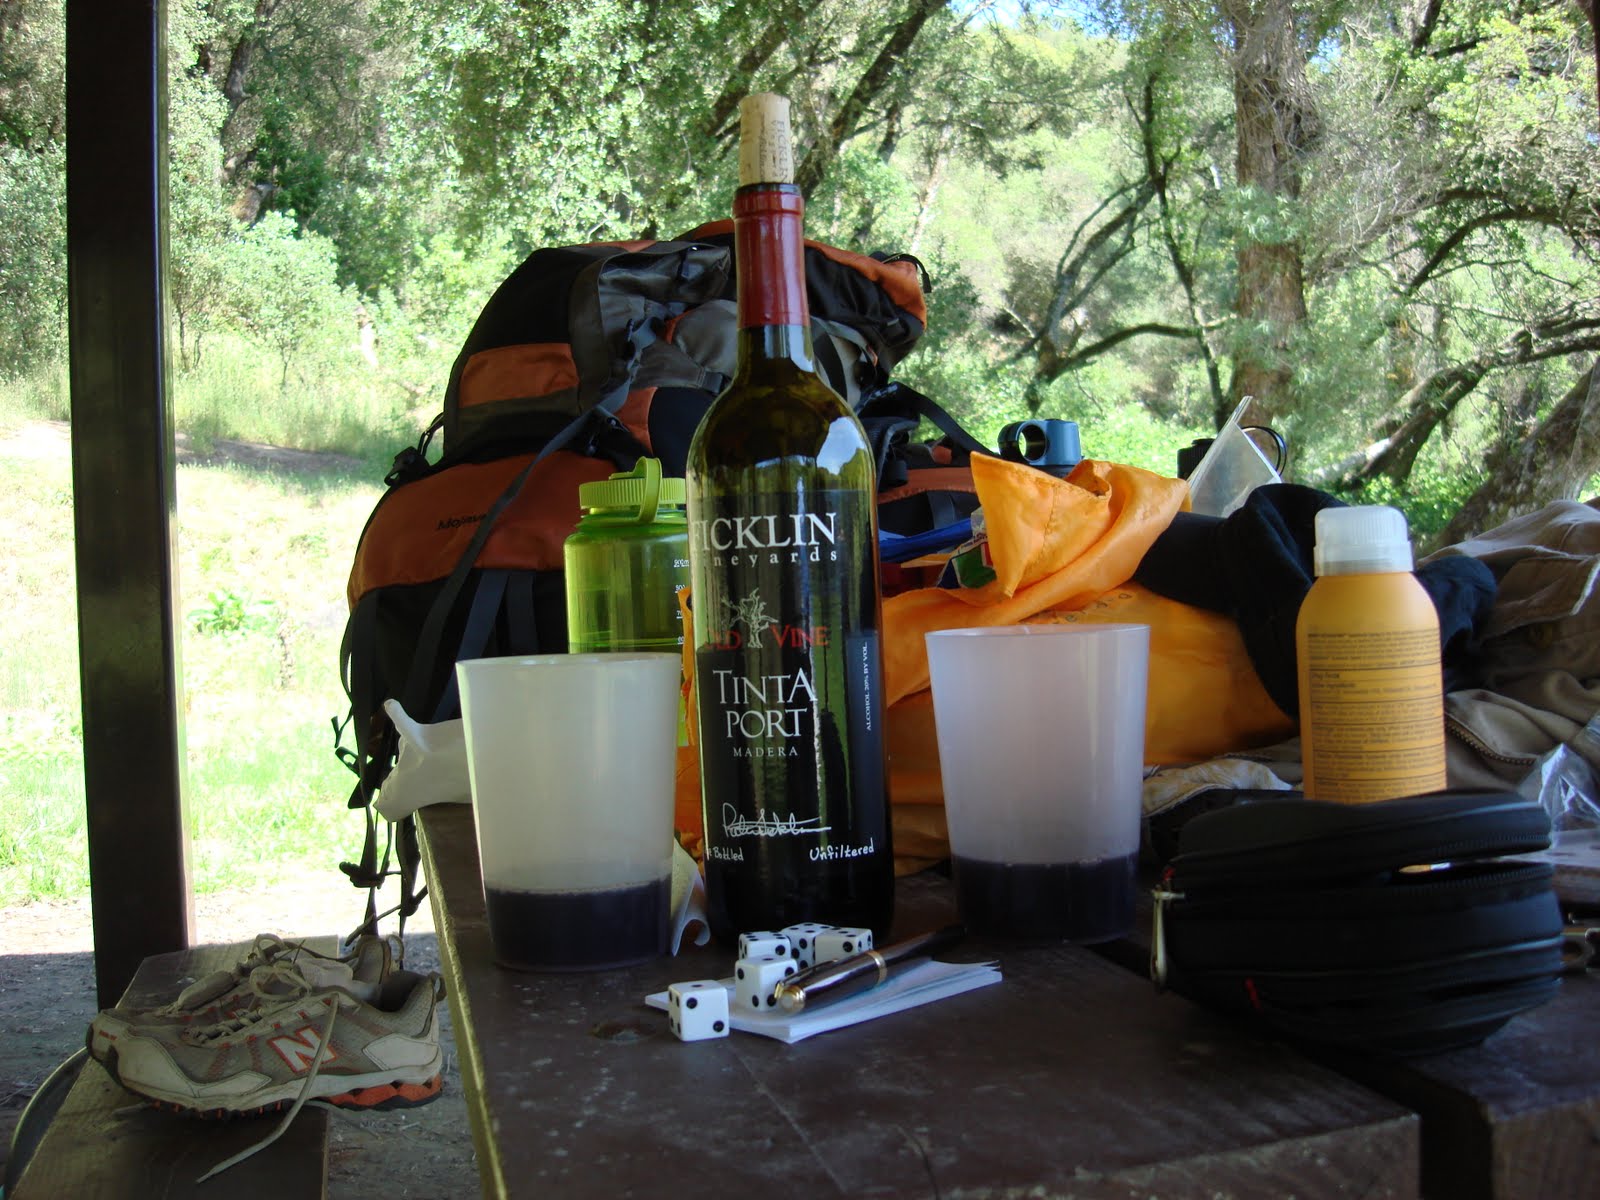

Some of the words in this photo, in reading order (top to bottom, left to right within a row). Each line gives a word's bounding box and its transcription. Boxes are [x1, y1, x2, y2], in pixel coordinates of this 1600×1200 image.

[689, 512, 837, 551] FICKLIN
[770, 623, 828, 648] VINE
[863, 662, 869, 674] BY
[712, 667, 818, 704] TINTA
[726, 708, 808, 738] PORT
[733, 746, 798, 757] MADERA
[809, 837, 874, 861] Unfiltered
[266, 1025, 337, 1073] N
